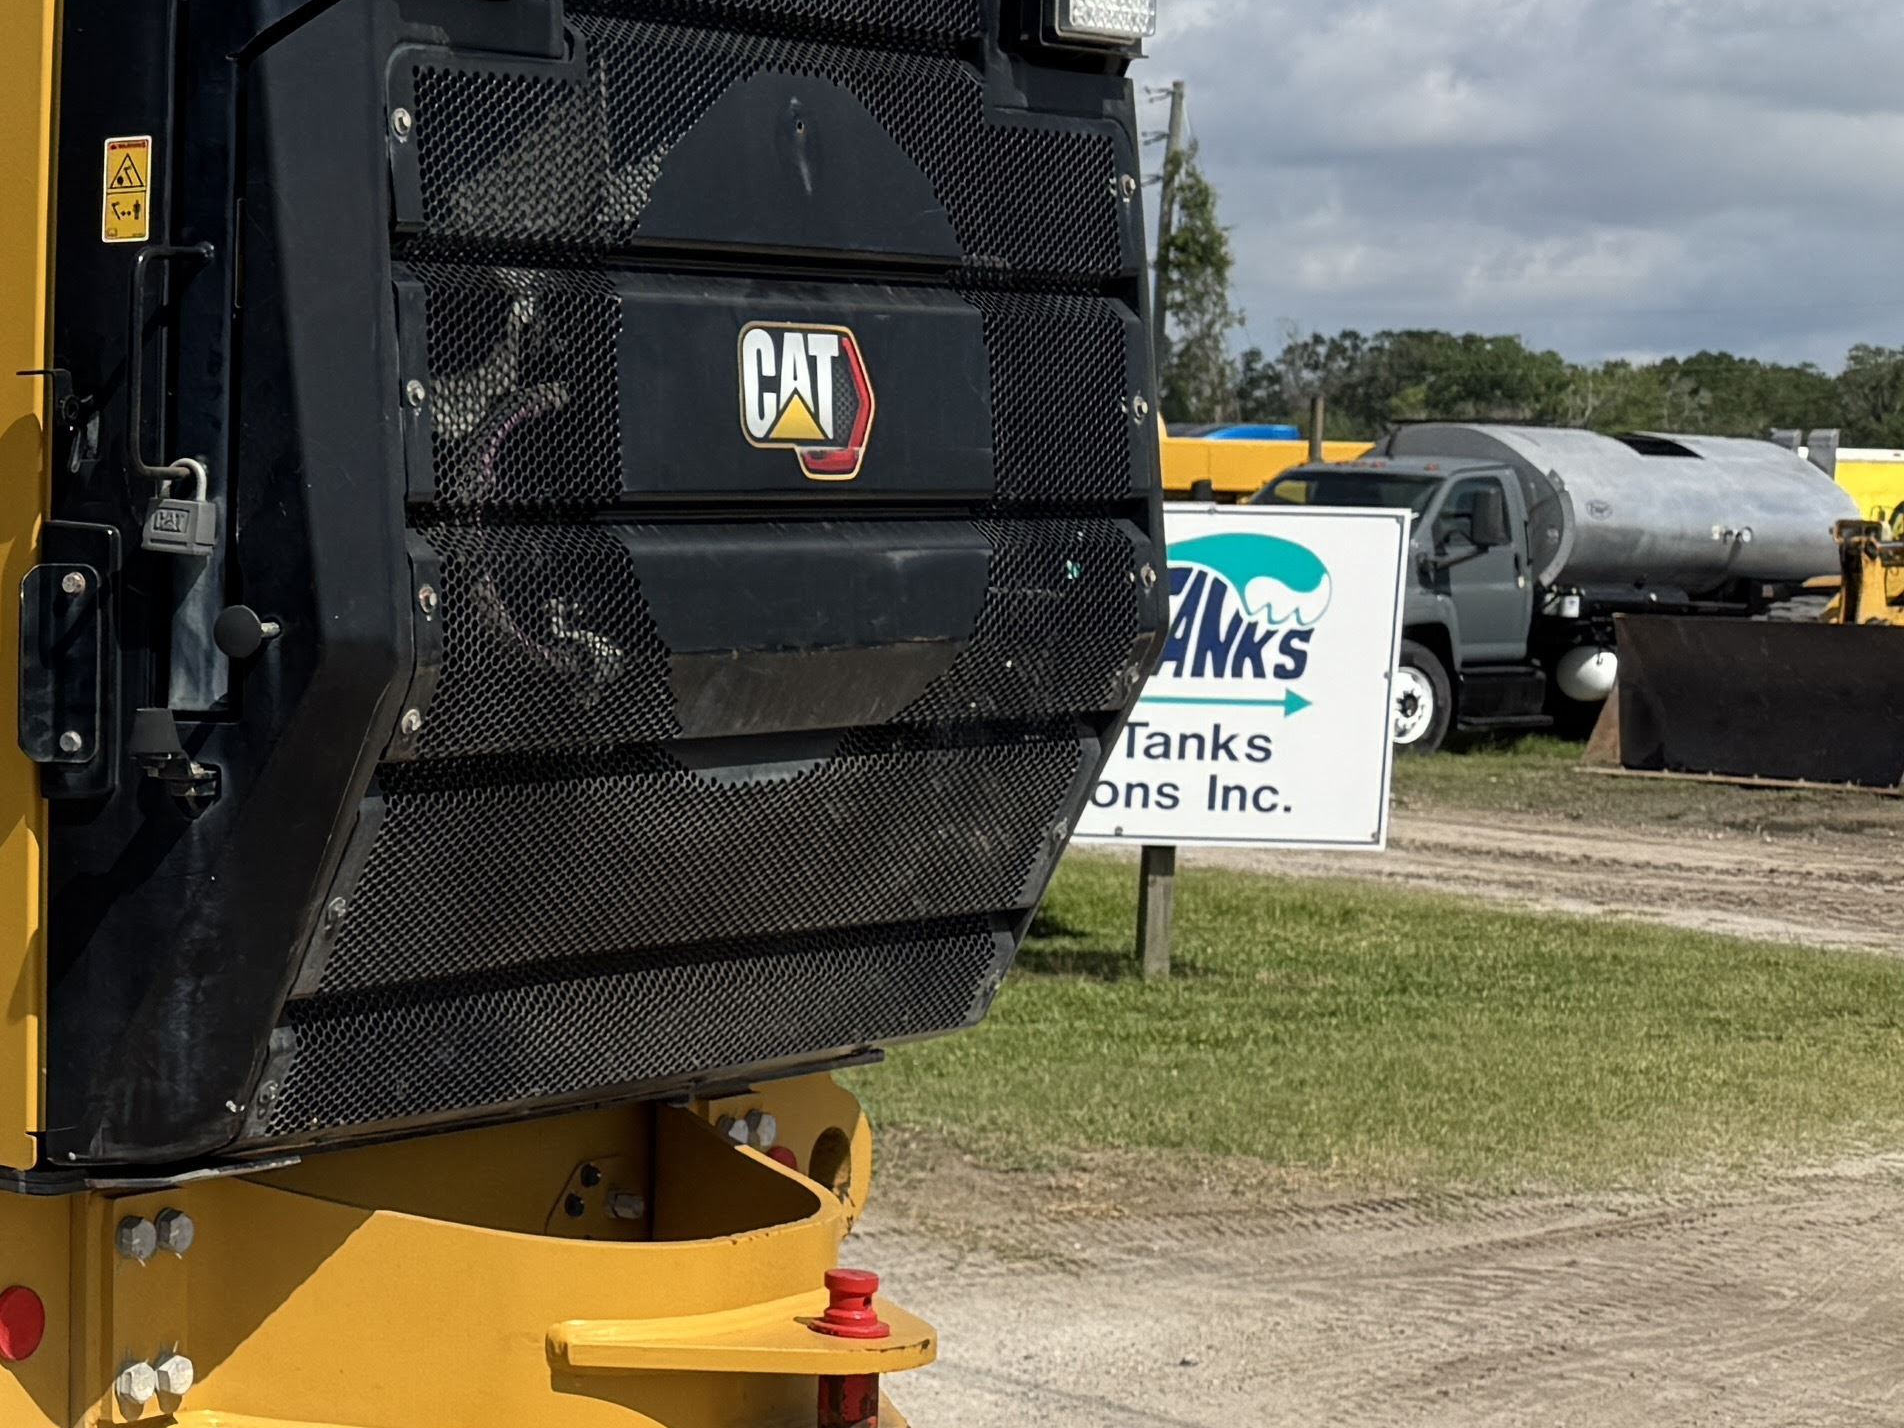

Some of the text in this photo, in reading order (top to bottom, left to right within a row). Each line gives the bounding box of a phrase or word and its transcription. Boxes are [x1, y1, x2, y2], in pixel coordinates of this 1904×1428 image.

[743, 328, 839, 439] CAT
[1124, 722, 1272, 763] Tanks
[1208, 775, 1291, 812] Inc.
